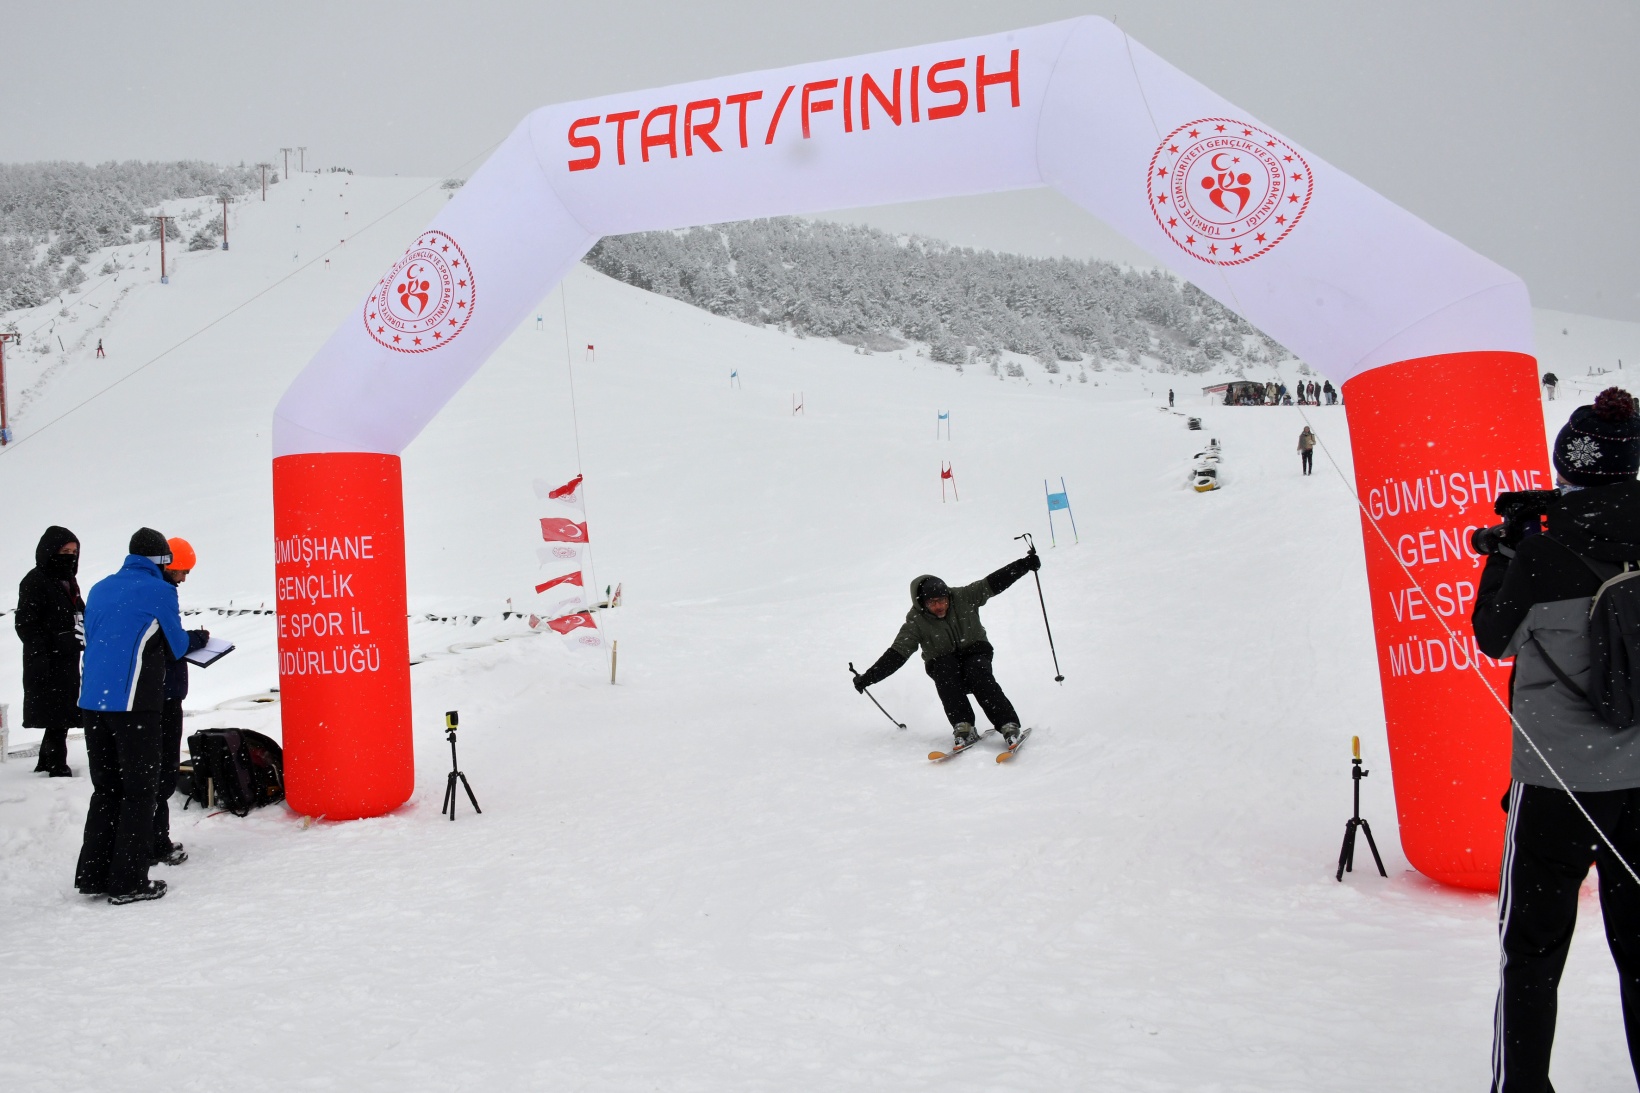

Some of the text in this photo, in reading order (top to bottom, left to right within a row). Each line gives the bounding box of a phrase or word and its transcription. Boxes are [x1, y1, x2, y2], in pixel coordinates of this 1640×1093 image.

[567, 48, 1021, 172] START/FINISH
[1175, 139, 1281, 236] TÜRKİYE CUMHURİYETİ GENÇLİK VE SPOR BAKANLIĞI
[433, 256, 442, 266] VE
[439, 264, 451, 286] SPOR
[425, 287, 451, 327] BAKANLIĞI
[275, 534, 374, 568] ÜMÜŞHANE
[278, 569, 355, 605] GENÇLİK
[1389, 581, 1475, 623] VE SP
[291, 612, 344, 637] SPOR
[351, 606, 370, 635] İL
[278, 644, 380, 676] ÜDÜRLÜĞÜ
